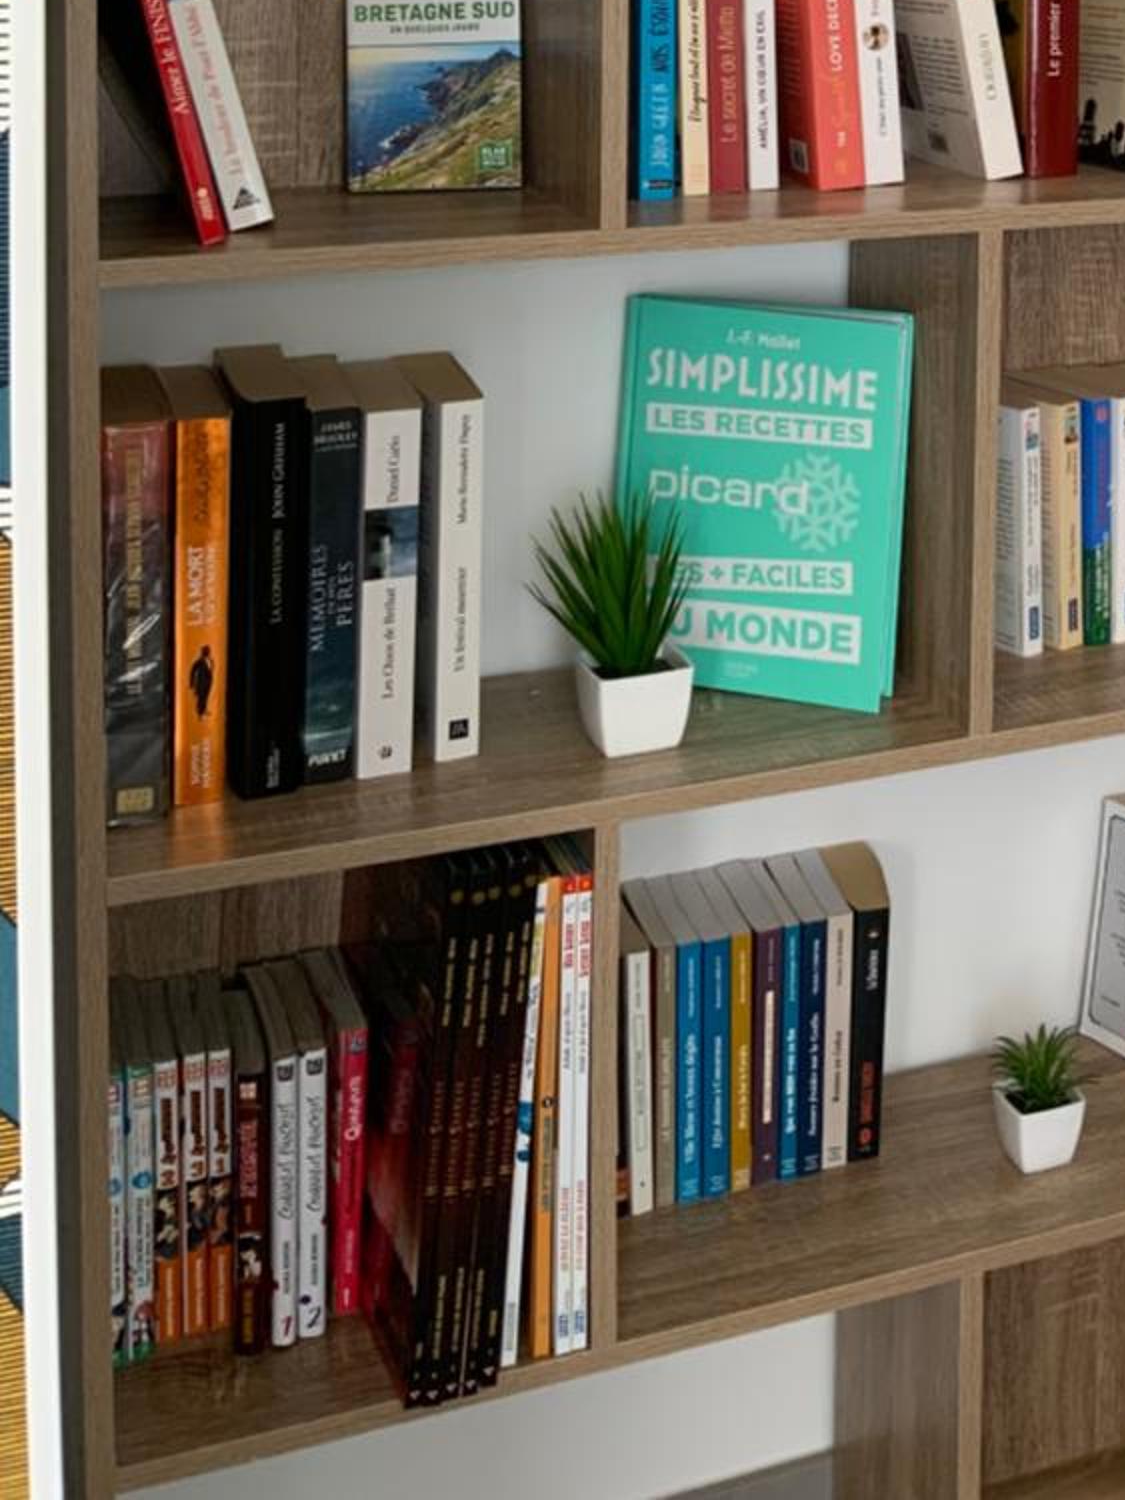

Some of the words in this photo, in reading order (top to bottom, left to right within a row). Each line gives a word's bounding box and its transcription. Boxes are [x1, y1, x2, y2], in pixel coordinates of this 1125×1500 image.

[353, 2, 465, 23] BRETAGNE
[472, 0, 515, 20] SUD
[1047, 2, 1063, 59] premier
[160, 48, 178, 64] le
[649, 43, 670, 74] NOS
[719, 53, 736, 73] de
[828, 36, 843, 72] LOVE
[1047, 61, 1060, 76] Le
[165, 64, 191, 116] Aimer
[649, 82, 669, 128] GREEN
[720, 75, 737, 120] secret
[719, 122, 736, 143] Le
[650, 133, 670, 168] JOHN
[645, 348, 879, 411] SIMPLISSIME
[653, 407, 706, 430] LES
[714, 412, 866, 444] RECETTES
[273, 422, 286, 480] GRISHAM
[272, 482, 286, 519] JOHN
[387, 468, 401, 503] Daniel
[648, 464, 811, 516] picard
[186, 545, 203, 598] MORT
[731, 563, 847, 589] FACILES
[187, 601, 203, 626] LA
[383, 626, 396, 638] de
[454, 615, 467, 653] festival
[706, 612, 853, 654] MONDE
[454, 655, 466, 672] Un
[381, 675, 395, 699] Les
